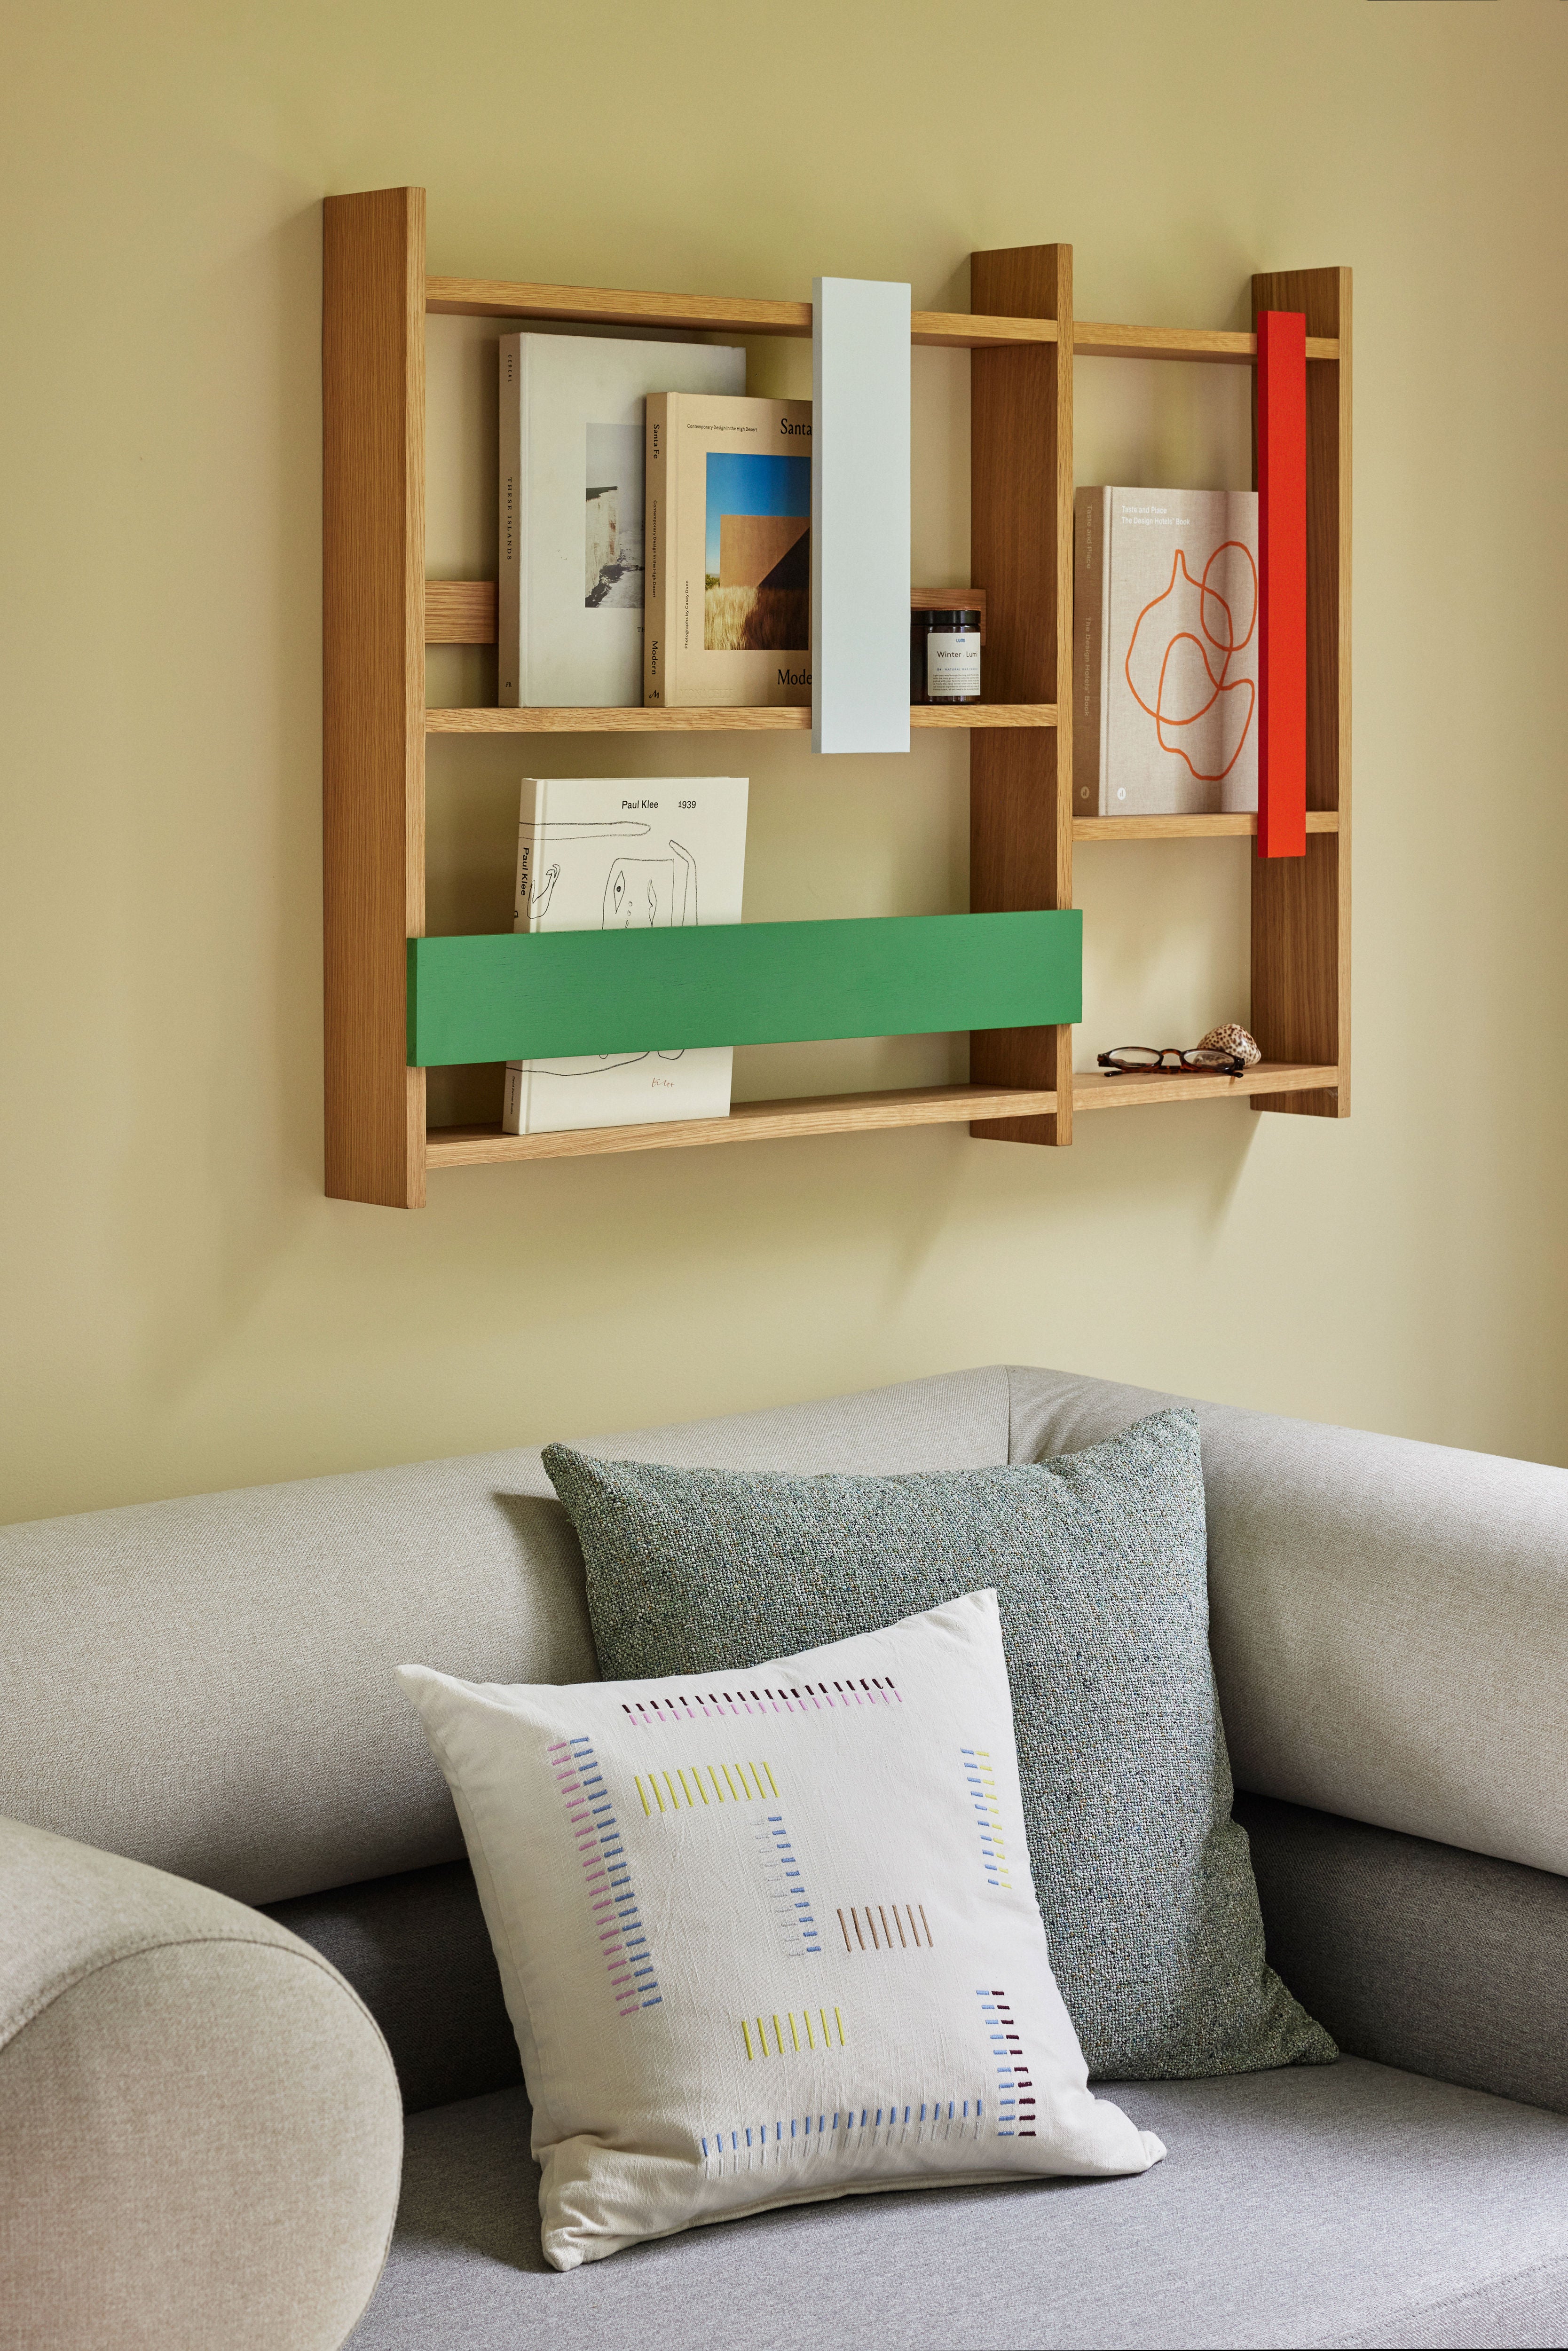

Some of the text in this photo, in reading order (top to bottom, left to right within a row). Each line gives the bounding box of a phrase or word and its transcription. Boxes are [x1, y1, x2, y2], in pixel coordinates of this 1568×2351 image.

[780, 418, 812, 435] Santa
[653, 449, 660, 459] Fe
[1134, 517, 1153, 526] Design
[778, 669, 812, 685] Mode
[622, 800, 696, 809] Paul Klee 1939
